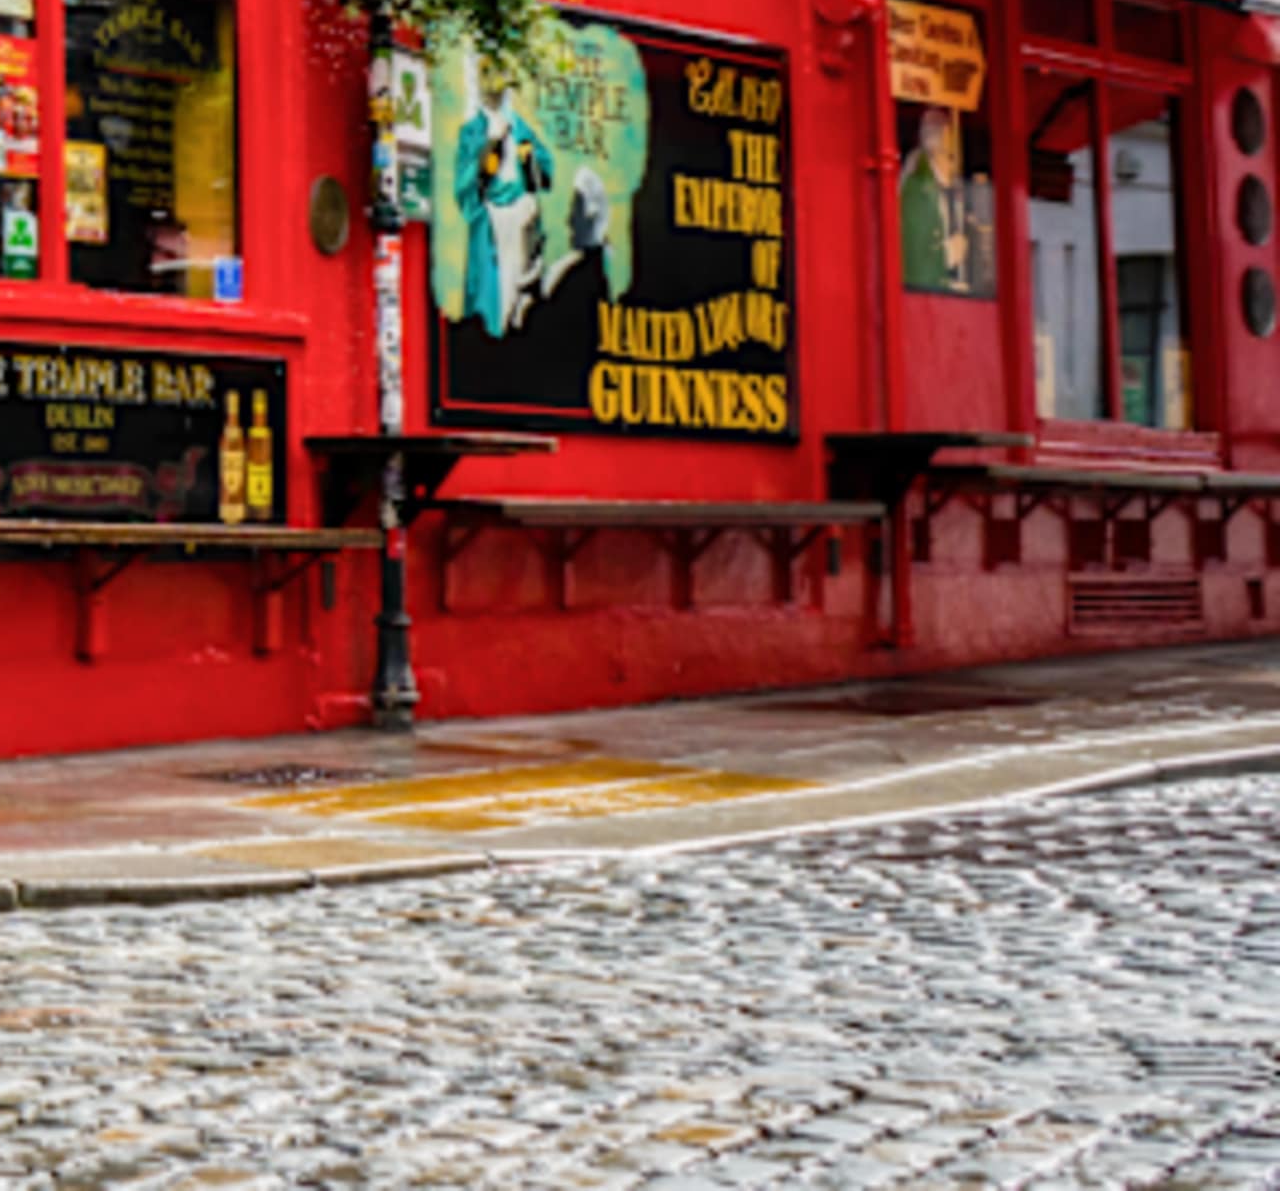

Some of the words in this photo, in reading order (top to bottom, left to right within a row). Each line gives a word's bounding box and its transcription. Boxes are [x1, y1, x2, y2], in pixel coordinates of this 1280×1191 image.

[727, 128, 780, 184] THE
[673, 173, 783, 237] EMPEROR
[751, 240, 781, 290] OF
[596, 300, 695, 360] MALTED
[13, 354, 146, 402] TEMPLE
[152, 362, 215, 406] BAR
[589, 360, 789, 432] GUINNESS
[45, 404, 114, 430] DUBLIN
